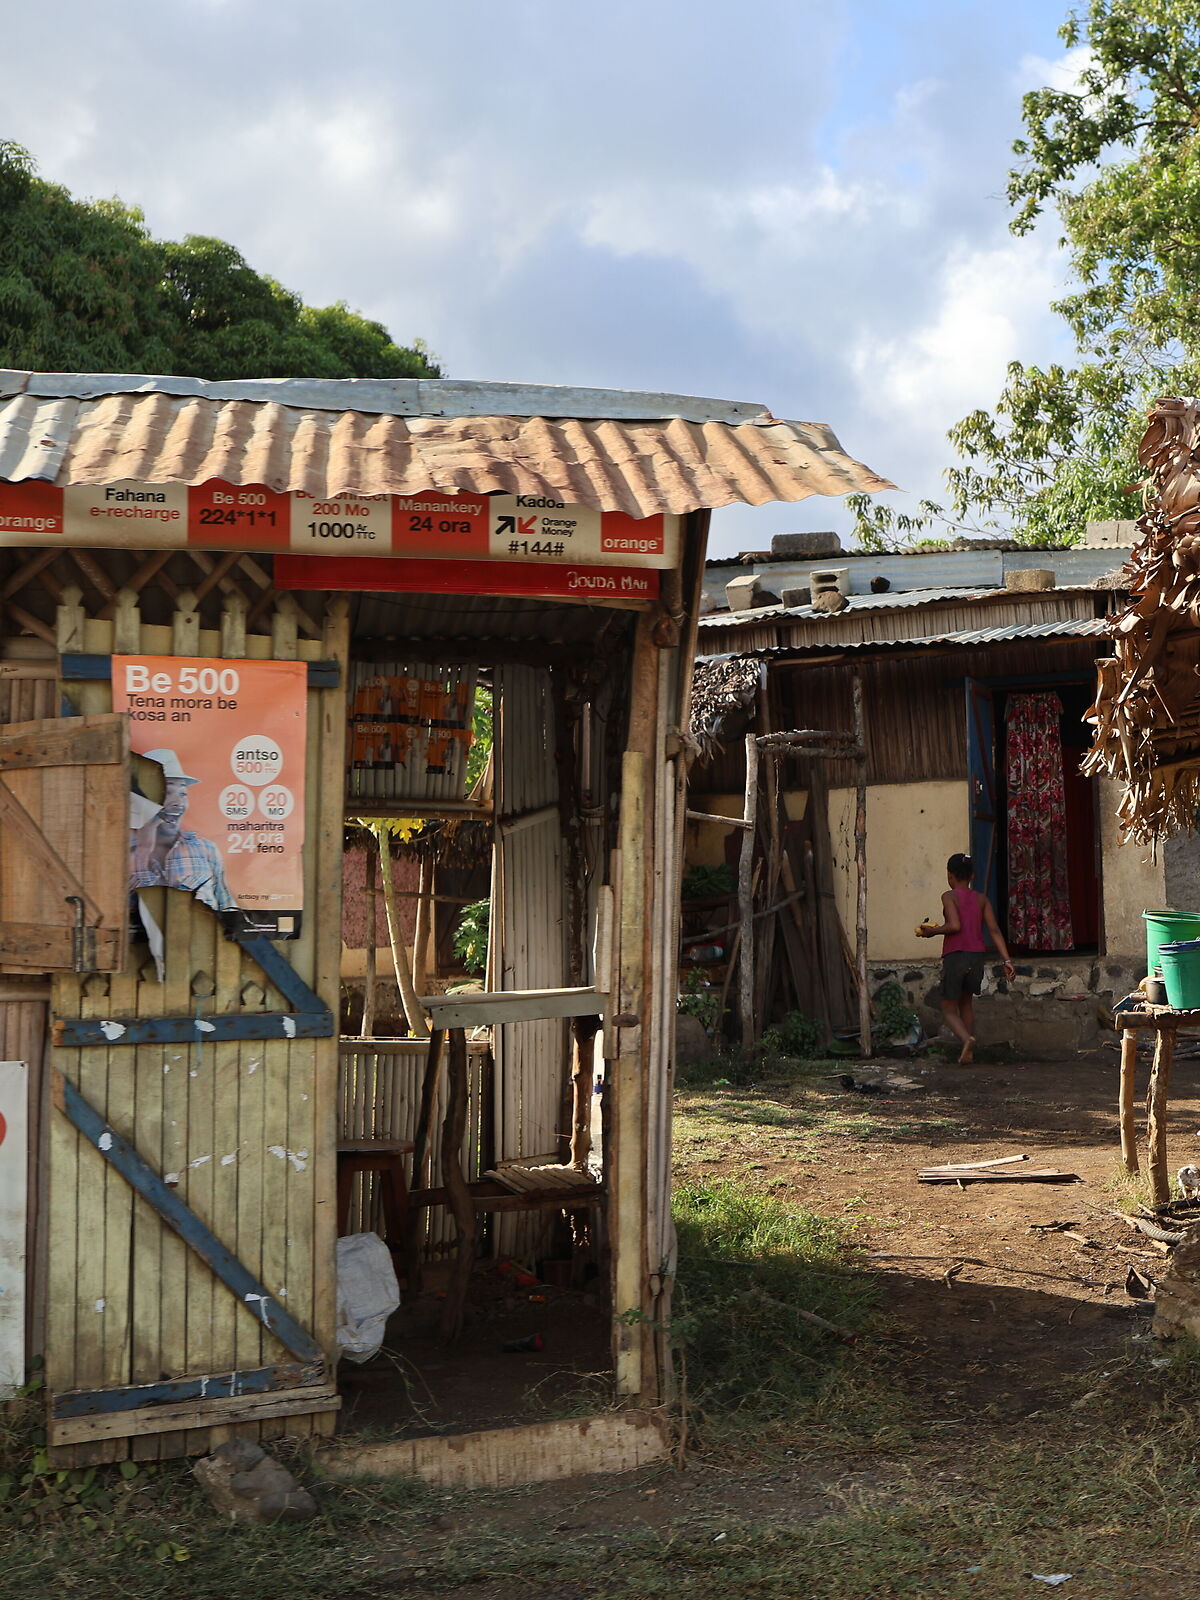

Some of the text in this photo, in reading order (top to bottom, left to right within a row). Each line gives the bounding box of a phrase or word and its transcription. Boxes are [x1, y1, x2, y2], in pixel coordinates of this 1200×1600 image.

[105, 487, 166, 503] Fahana
[212, 491, 267, 506] Be 500
[516, 495, 565, 509] Kadoa
[90, 505, 181, 522] e-recharge
[312, 502, 370, 517] 200 Mo
[399, 498, 483, 516] Manankery
[307, 522, 355, 538] 1000
[409, 515, 472, 533] 24 ora
[541, 517, 577, 528] Orange
[355, 531, 376, 540] TTC
[541, 526, 574, 538] Money
[508, 540, 565, 557] #144#
[603, 537, 658, 552] orange
[125, 664, 240, 696] Be 500
[126, 693, 238, 710] Tena mora be
[126, 707, 192, 722] kosa an
[236, 748, 279, 761] antso
[236, 761, 263, 774] 500
[225, 791, 248, 807] 20
[265, 792, 288, 807] 20
[225, 807, 249, 816] SMS
[268, 807, 285, 816] MO
[227, 821, 285, 831] maharitra
[227, 832, 285, 854] 24 ora
[257, 842, 285, 854] feno
